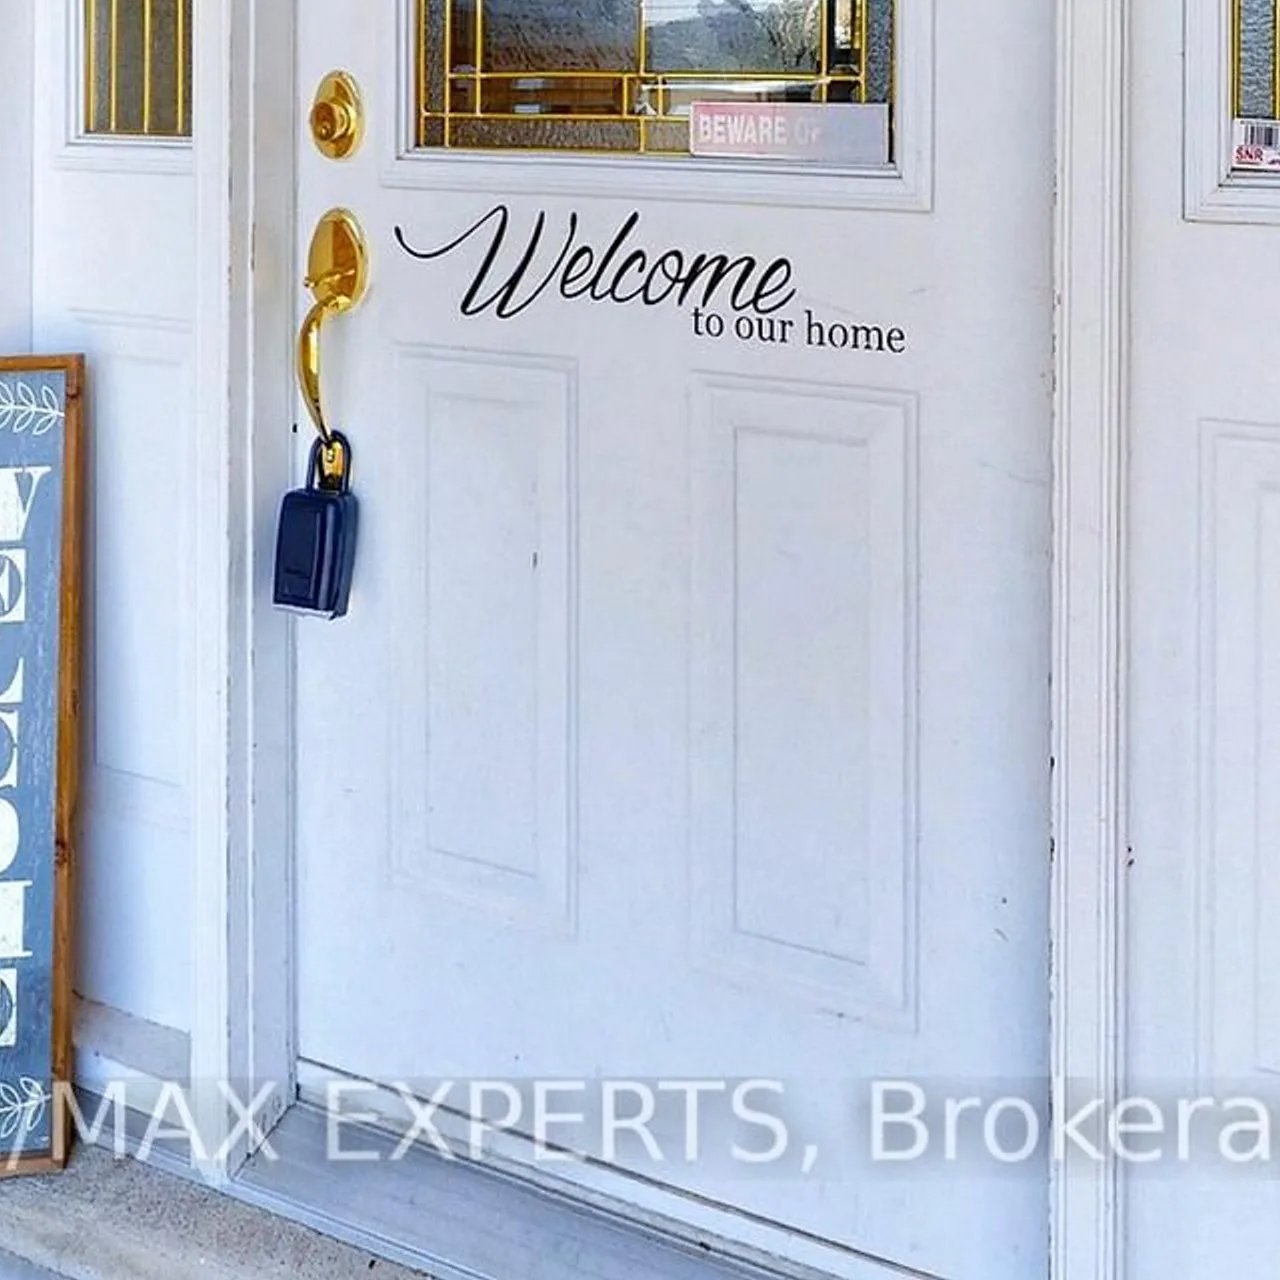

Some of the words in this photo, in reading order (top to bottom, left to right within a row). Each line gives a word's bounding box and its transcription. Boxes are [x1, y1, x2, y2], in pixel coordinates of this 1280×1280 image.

[699, 113, 788, 146] BEWARE
[394, 204, 797, 319] Welcome
[692, 307, 724, 338] to
[735, 314, 795, 344] our
[805, 310, 906, 354] home
